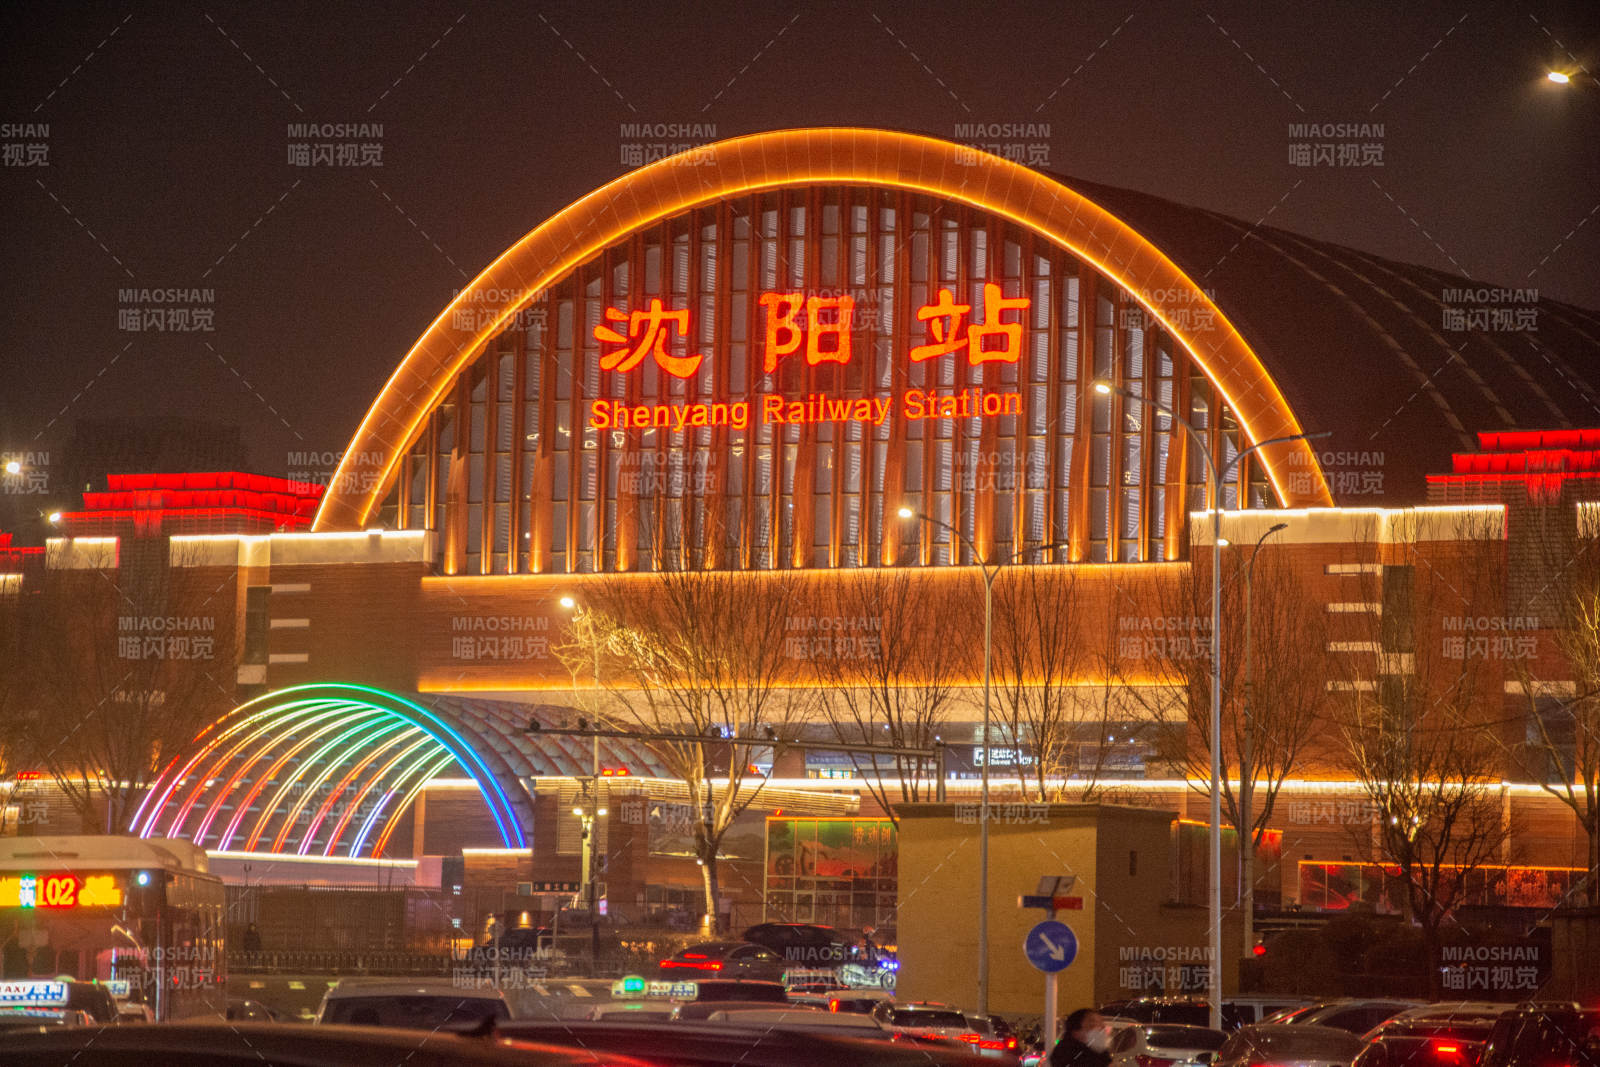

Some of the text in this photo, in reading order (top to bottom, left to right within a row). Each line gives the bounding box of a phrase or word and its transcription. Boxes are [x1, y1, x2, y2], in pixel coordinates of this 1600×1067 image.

[591, 283, 1031, 378] 沈阳站
[589, 387, 1022, 433] Shenyang Railway Station
[36, 877, 76, 906] 102
